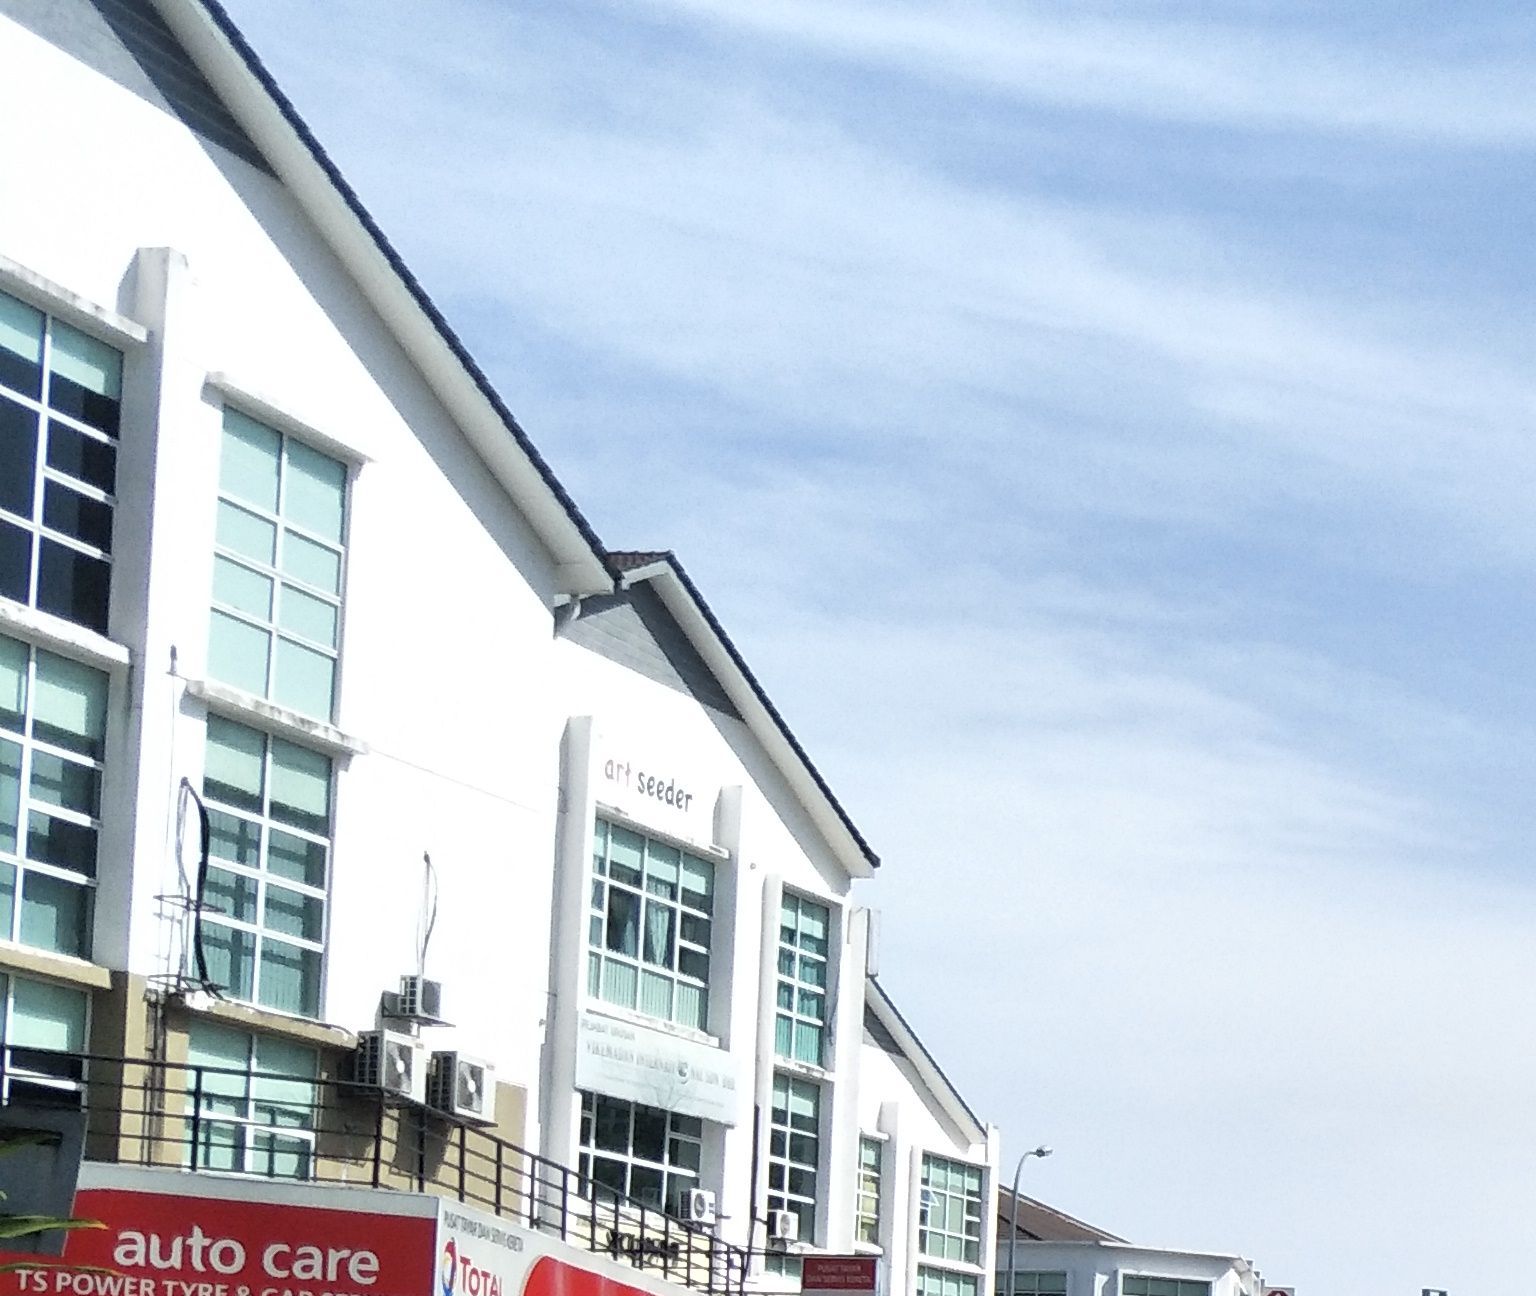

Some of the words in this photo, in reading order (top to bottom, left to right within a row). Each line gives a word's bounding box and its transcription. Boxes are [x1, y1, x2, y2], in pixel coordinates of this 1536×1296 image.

[605, 759, 631, 787] art
[638, 772, 692, 812] seeder
[15, 1270, 47, 1291] TS
[113, 1225, 246, 1274] auto
[262, 1241, 380, 1285] care
